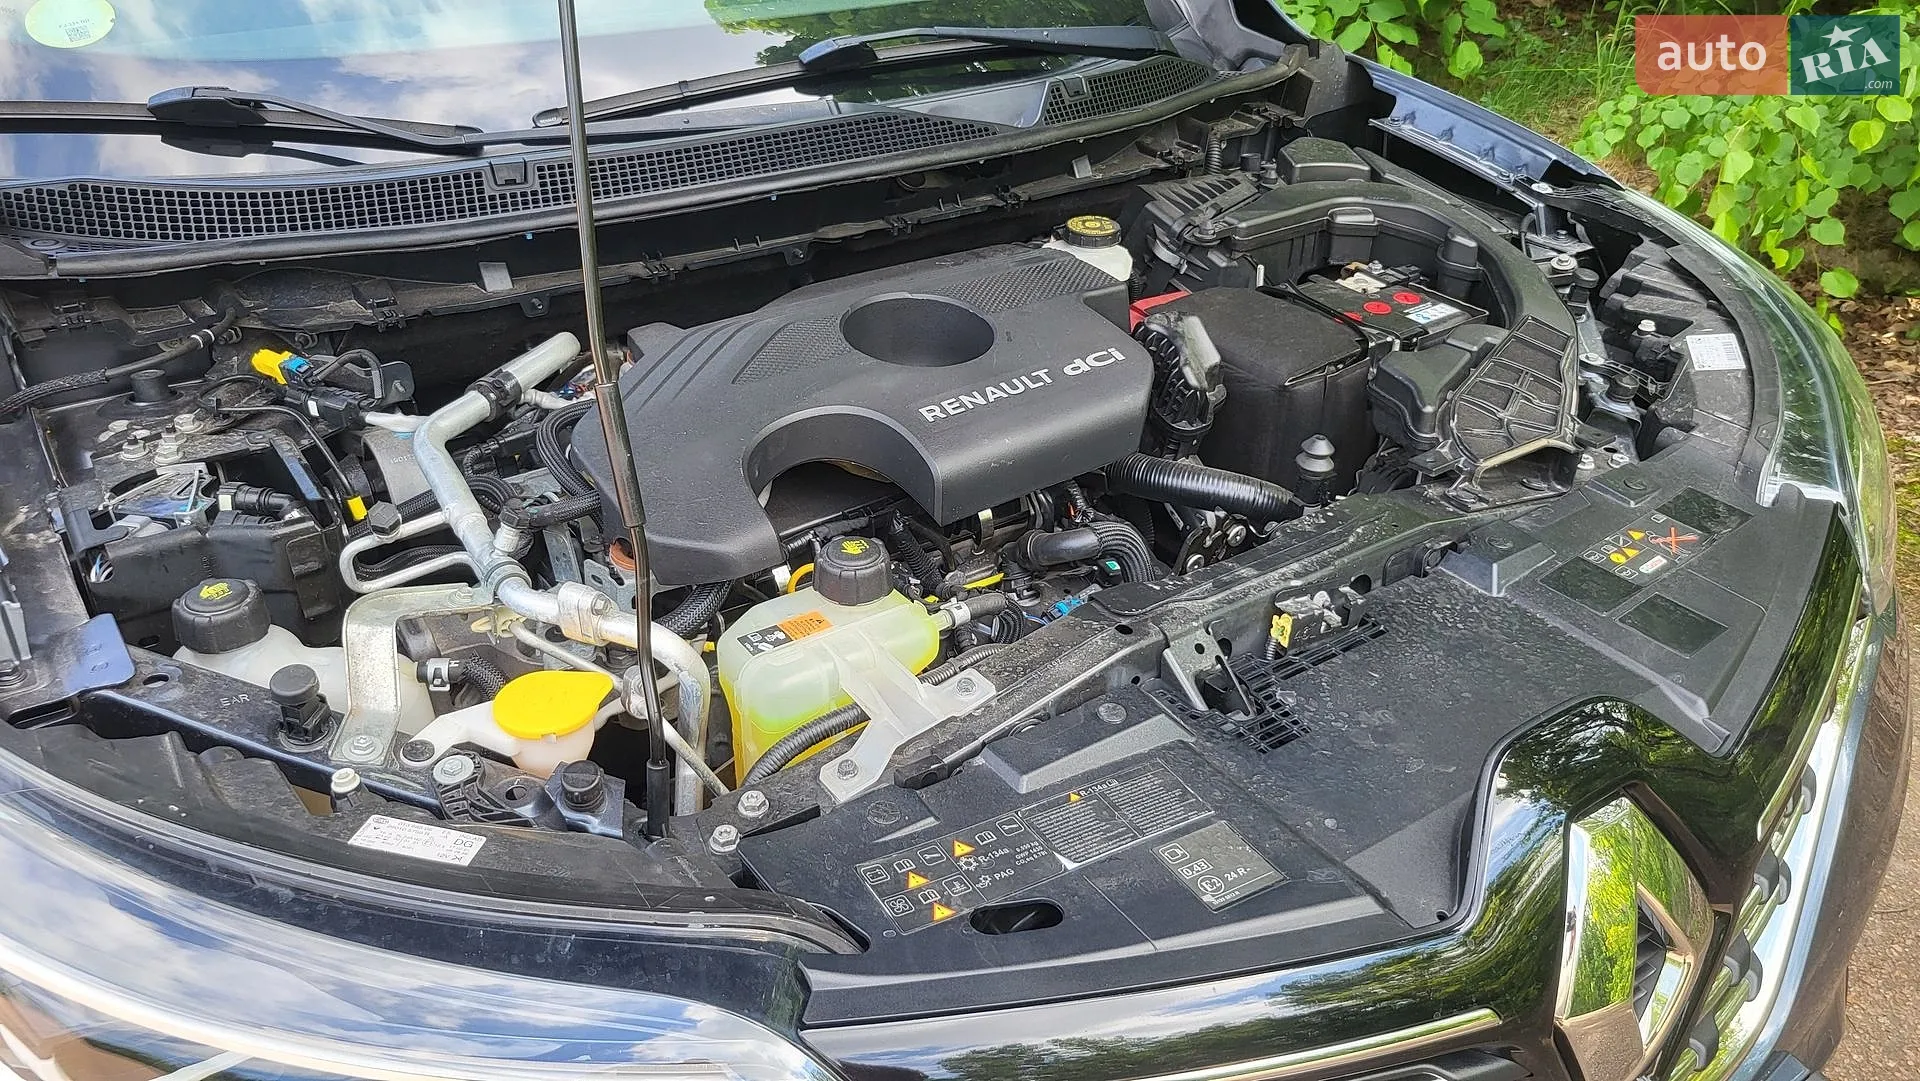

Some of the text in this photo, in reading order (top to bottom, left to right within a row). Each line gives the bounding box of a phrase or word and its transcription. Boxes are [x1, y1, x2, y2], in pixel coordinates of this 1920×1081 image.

[918, 347, 1126, 423] RENAULT dCi
[454, 838, 474, 848] DG
[978, 847, 1010, 863] R-134a
[993, 868, 1015, 880] PAG
[1182, 861, 1209, 877] 0,43
[1201, 878, 1221, 891] E2
[1224, 871, 1236, 882] 24
